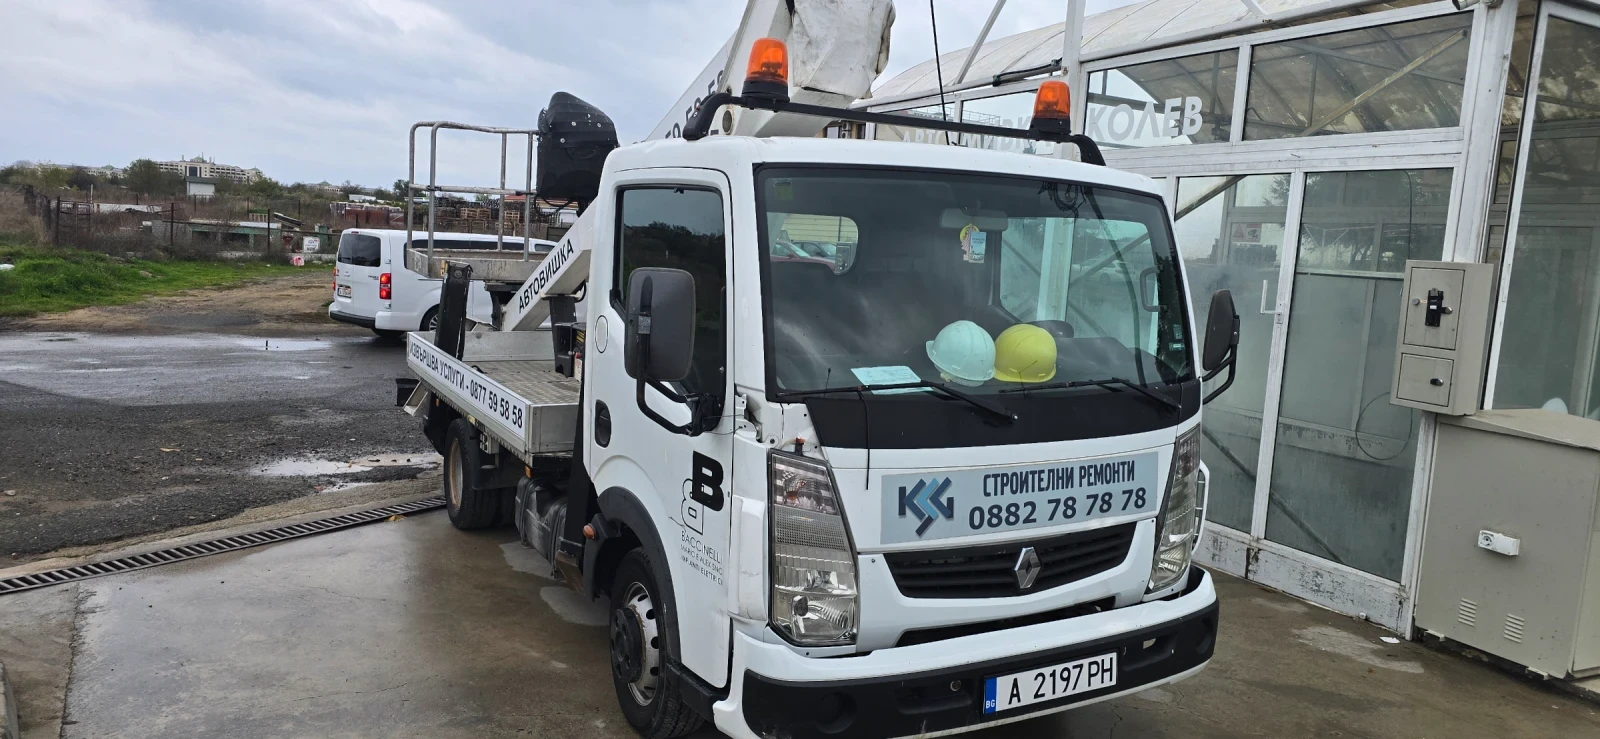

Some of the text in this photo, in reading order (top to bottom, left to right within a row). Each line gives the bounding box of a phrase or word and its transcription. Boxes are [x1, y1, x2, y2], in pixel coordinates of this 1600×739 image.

[1088, 96, 1203, 141] КОЛЕВ
[518, 238, 574, 314] АВТОВИШКА
[410, 341, 439, 374] ИЗВЪРШВА
[440, 360, 465, 391] УСЛУГИ
[470, 379, 487, 404] 0877
[488, 391, 498, 412] 59
[500, 398, 510, 421] 58
[512, 405, 523, 429] 58
[692, 450, 725, 512] B
[983, 460, 1135, 497] СТРОИТЕЛНИ РЕМОНТИ
[969, 487, 1147, 530] 0882 78 78 78
[681, 530, 723, 565] BACCINELLI
[1008, 657, 1113, 705] A 2197 PH
[985, 699, 996, 709] BG
